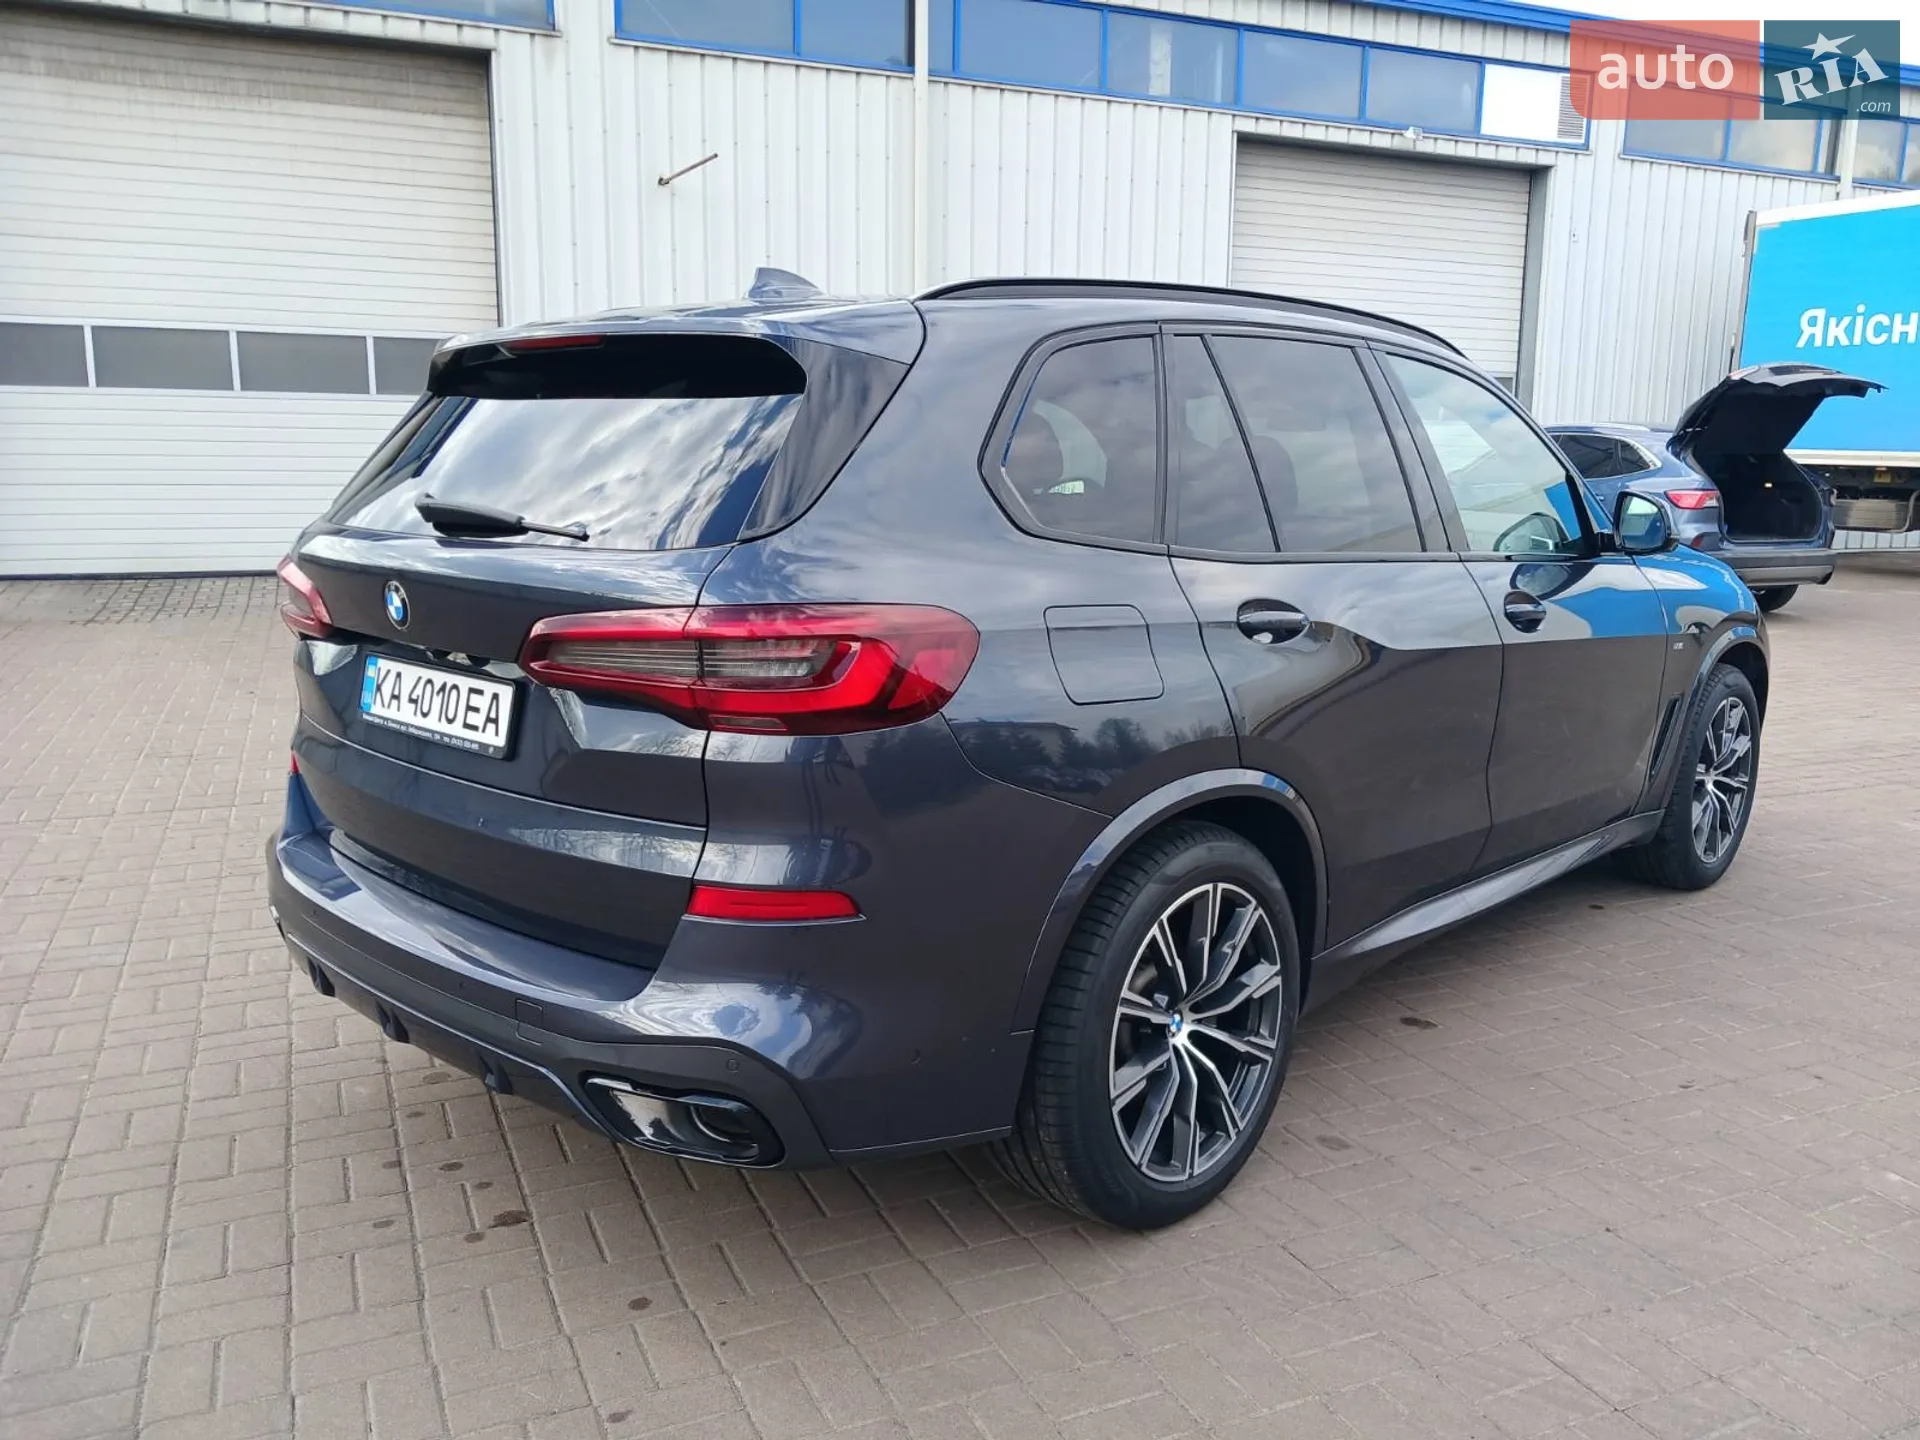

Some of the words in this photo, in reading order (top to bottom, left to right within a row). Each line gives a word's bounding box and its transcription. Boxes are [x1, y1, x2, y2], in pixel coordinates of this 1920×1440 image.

[1795, 303, 1919, 349] Якісн
[373, 666, 402, 712] KA
[407, 675, 461, 725] 4010
[462, 687, 500, 737] EA
